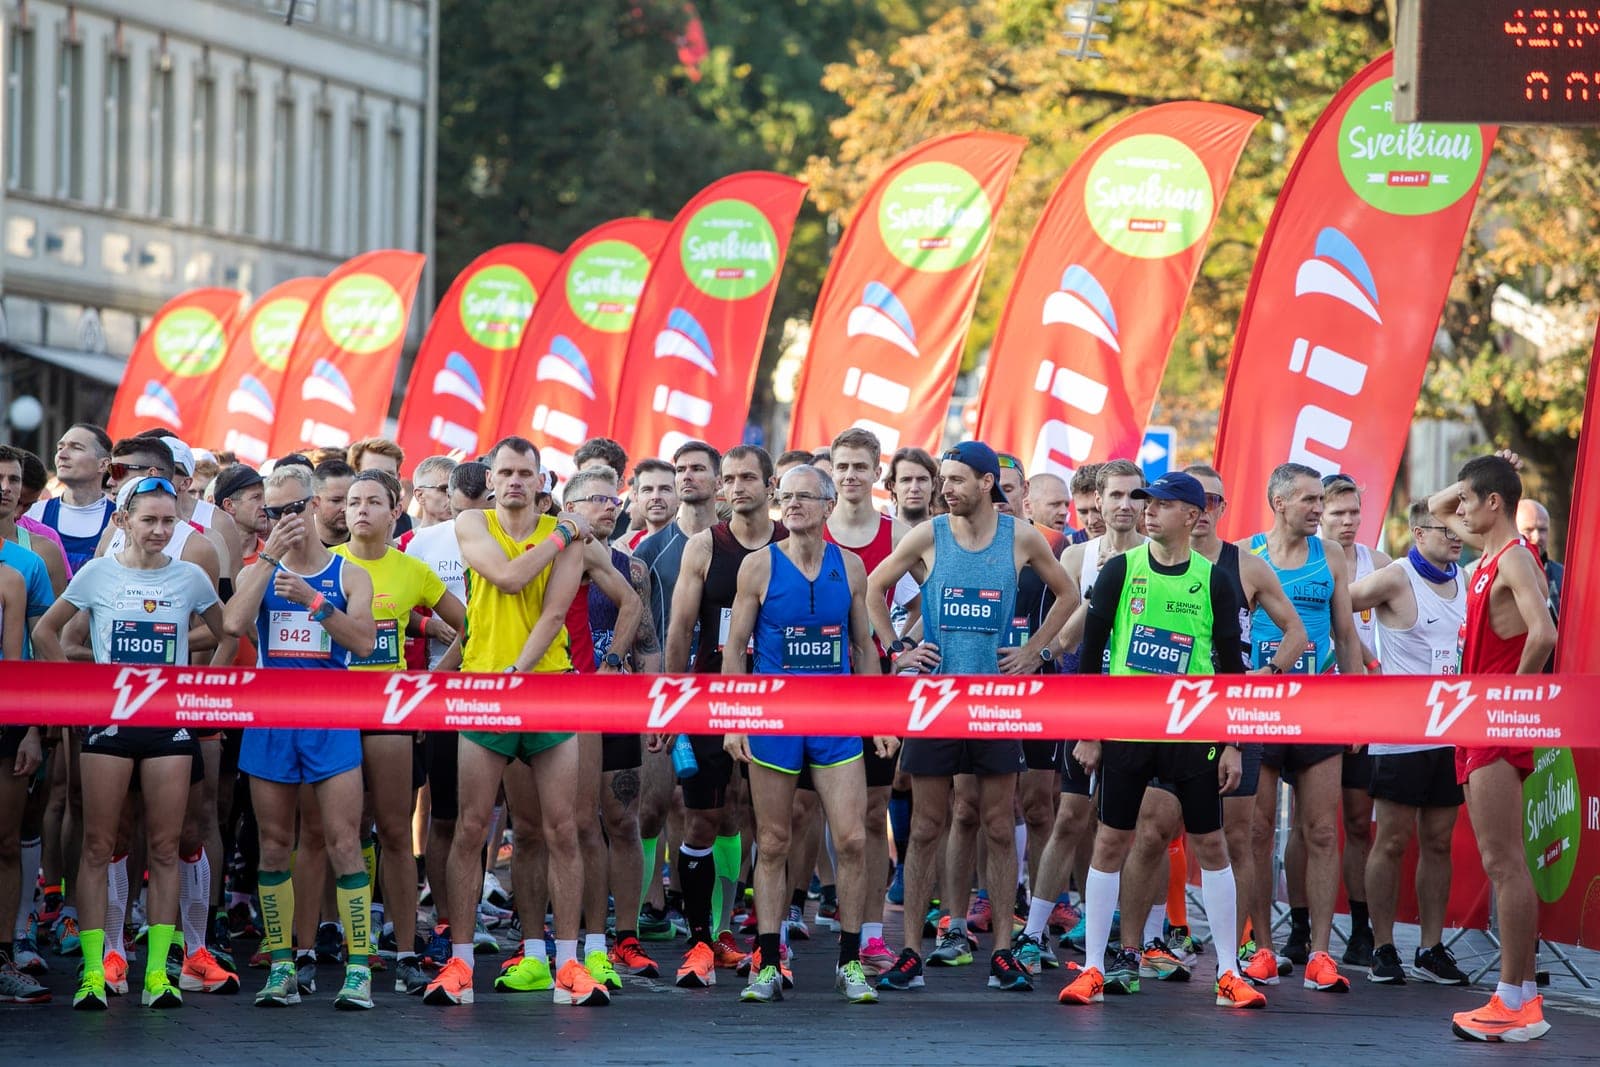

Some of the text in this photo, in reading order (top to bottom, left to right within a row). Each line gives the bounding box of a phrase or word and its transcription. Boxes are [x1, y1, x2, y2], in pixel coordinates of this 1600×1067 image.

[1349, 122, 1472, 161] Sveikiau
[1094, 173, 1203, 211] Sveikiau
[1131, 586, 1147, 595] LTU
[943, 602, 991, 618] 10659
[279, 628, 311, 642] 942
[117, 637, 164, 654] 11305
[787, 641, 831, 656] 11052
[1132, 640, 1180, 662] 10785
[176, 693, 233, 709] Vilniaus
[445, 697, 502, 714] Vilniaus
[708, 701, 764, 717] Vilniaus
[176, 709, 254, 722] maratonas
[445, 714, 522, 726] maratonas
[967, 704, 1023, 720] Vilniaus
[1225, 706, 1282, 723] Vilniaus
[1486, 709, 1541, 725] Vilniaus
[708, 717, 785, 730] maratonas
[967, 719, 1044, 733] maratonas
[1225, 721, 1302, 736] maratonas
[1486, 725, 1562, 739] maratonas
[1527, 772, 1576, 842] Sveikiau
[263, 894, 284, 945] LIETUVA
[349, 896, 367, 949] LIETUVA
